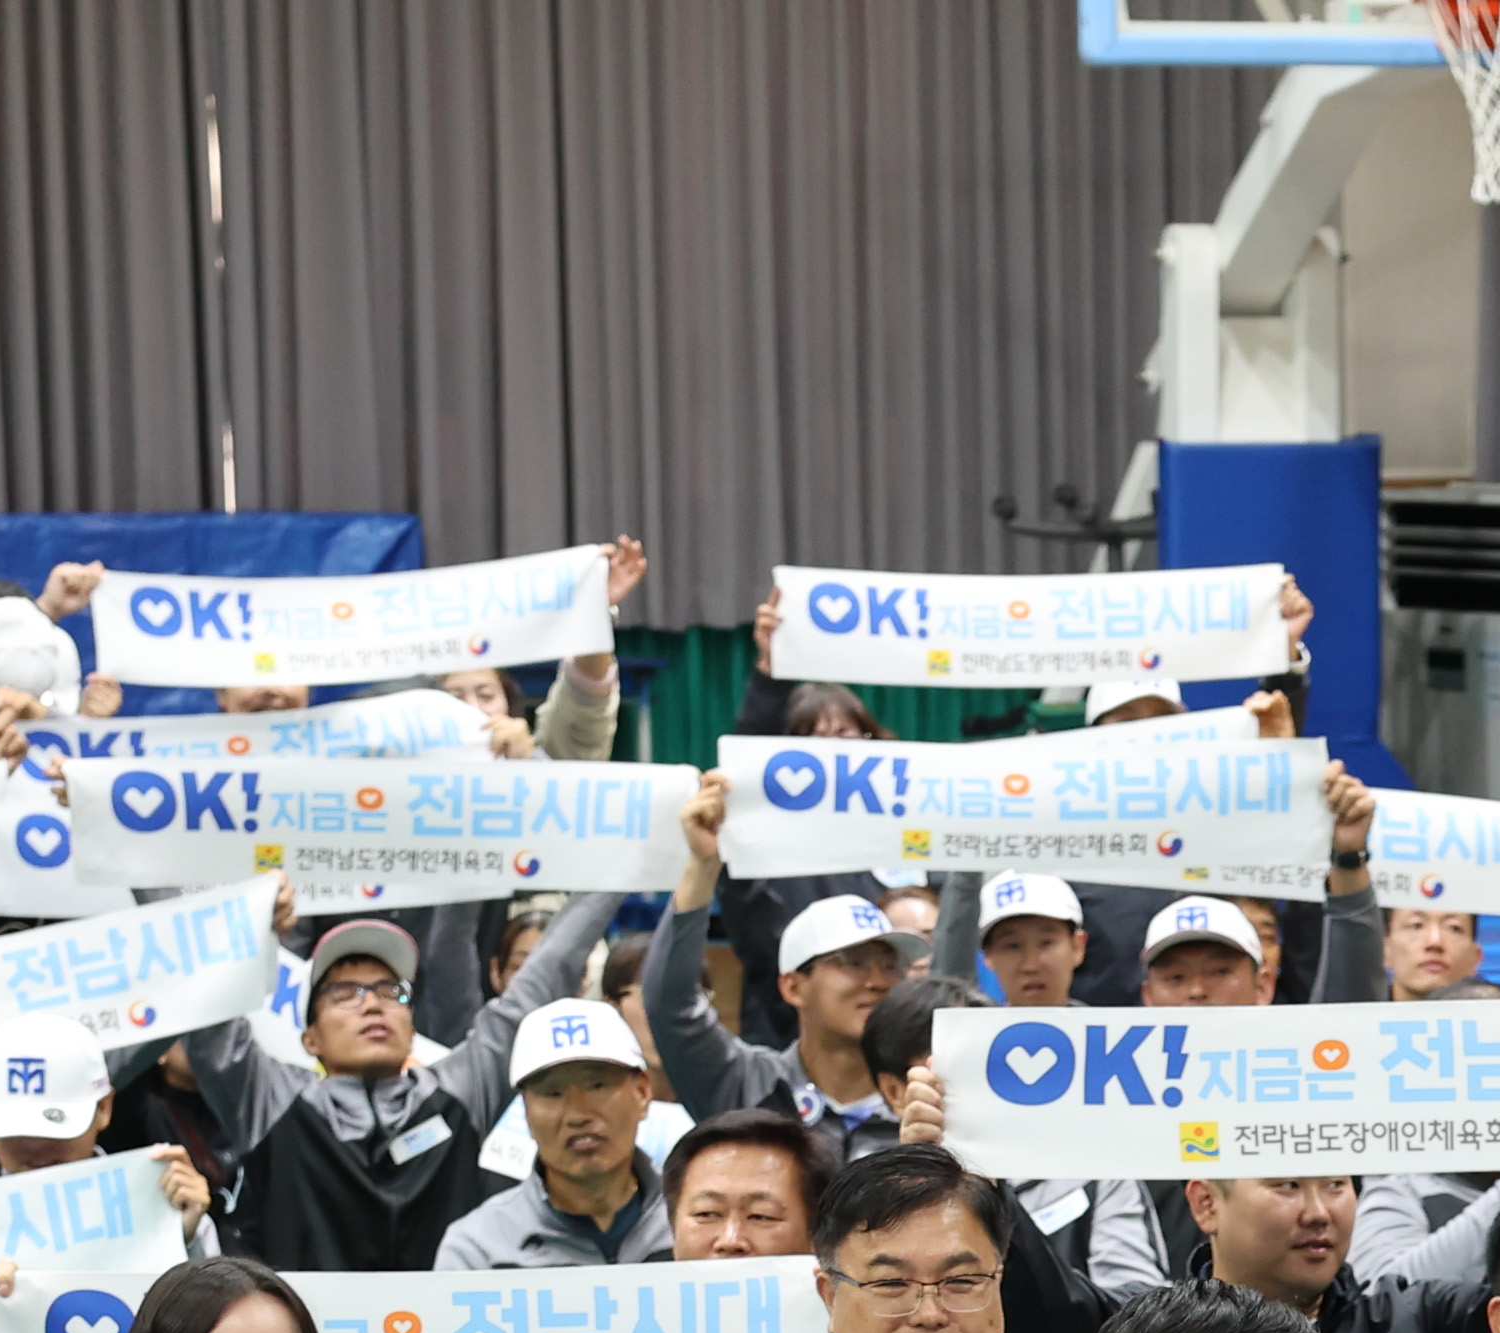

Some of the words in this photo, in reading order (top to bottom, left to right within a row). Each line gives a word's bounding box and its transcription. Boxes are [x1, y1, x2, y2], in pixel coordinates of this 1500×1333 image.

[130, 587, 252, 640] OK!
[261, 602, 361, 639] 지금은
[372, 563, 574, 629] 전남시대
[808, 582, 929, 638] OK!
[938, 601, 1035, 639] 지금은
[1049, 580, 1250, 640] 전남시대
[111, 770, 260, 833] OK!
[270, 786, 387, 832] 지금은
[407, 773, 652, 839] 전남시대
[763, 750, 909, 816] OK!
[918, 773, 1035, 818] 지금은
[1051, 752, 1292, 820] 전남시대
[2, 896, 258, 1017] 전남시대
[986, 1021, 1190, 1108] OK!
[1199, 1039, 1356, 1103] 지금은
